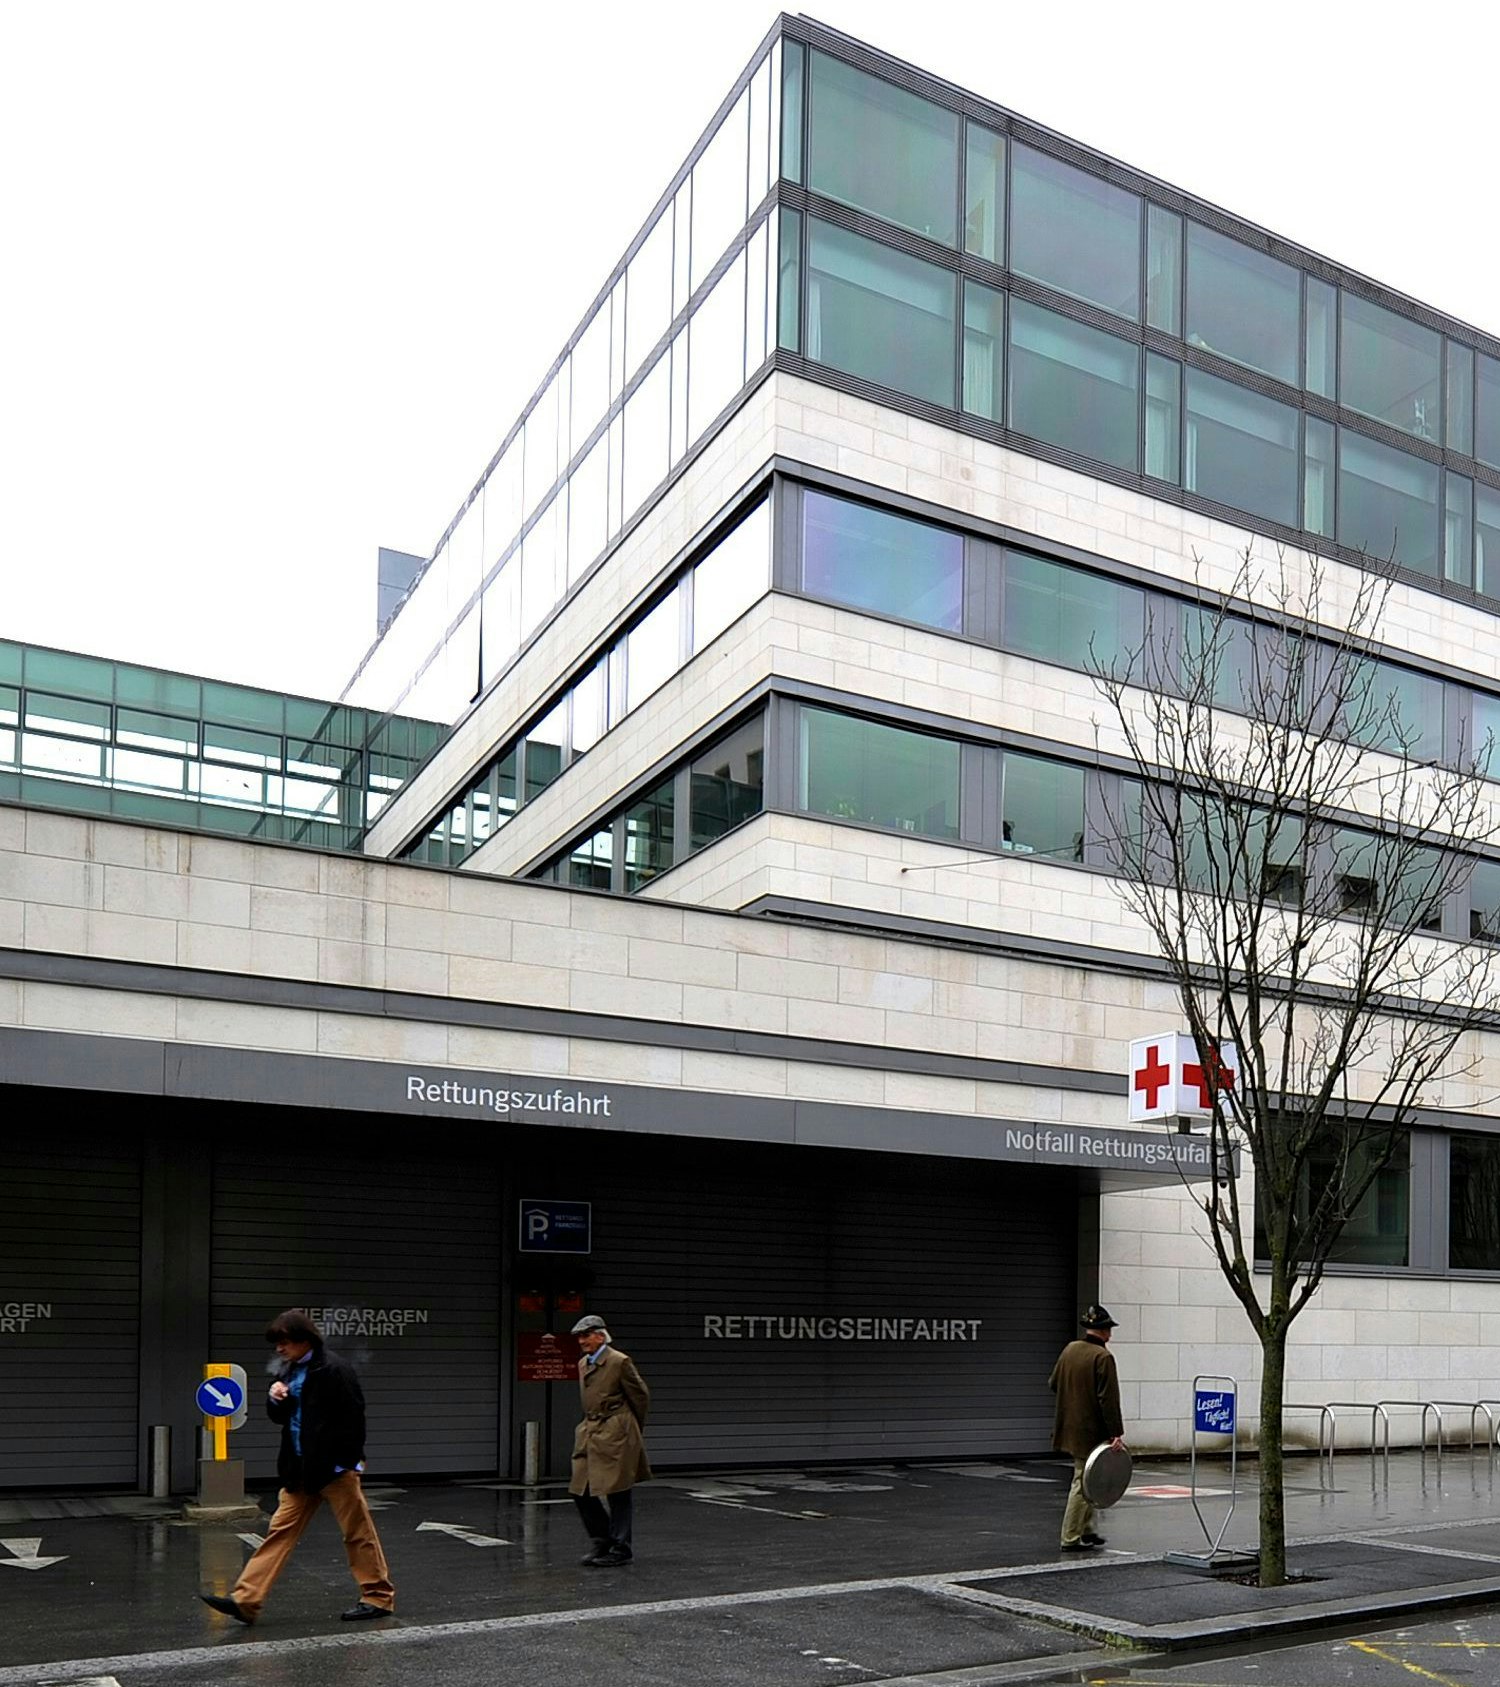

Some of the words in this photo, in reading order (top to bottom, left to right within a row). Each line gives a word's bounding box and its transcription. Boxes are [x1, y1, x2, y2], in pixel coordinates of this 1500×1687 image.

[407, 1075, 611, 1117] Rettungszufahrt
[1006, 1129, 1074, 1154] Notfall
[1080, 1136, 1226, 1166] Rettungszufar
[314, 1322, 407, 1337] EINFAHRT
[704, 1315, 982, 1341] RETTUNGSEINFAHRT
